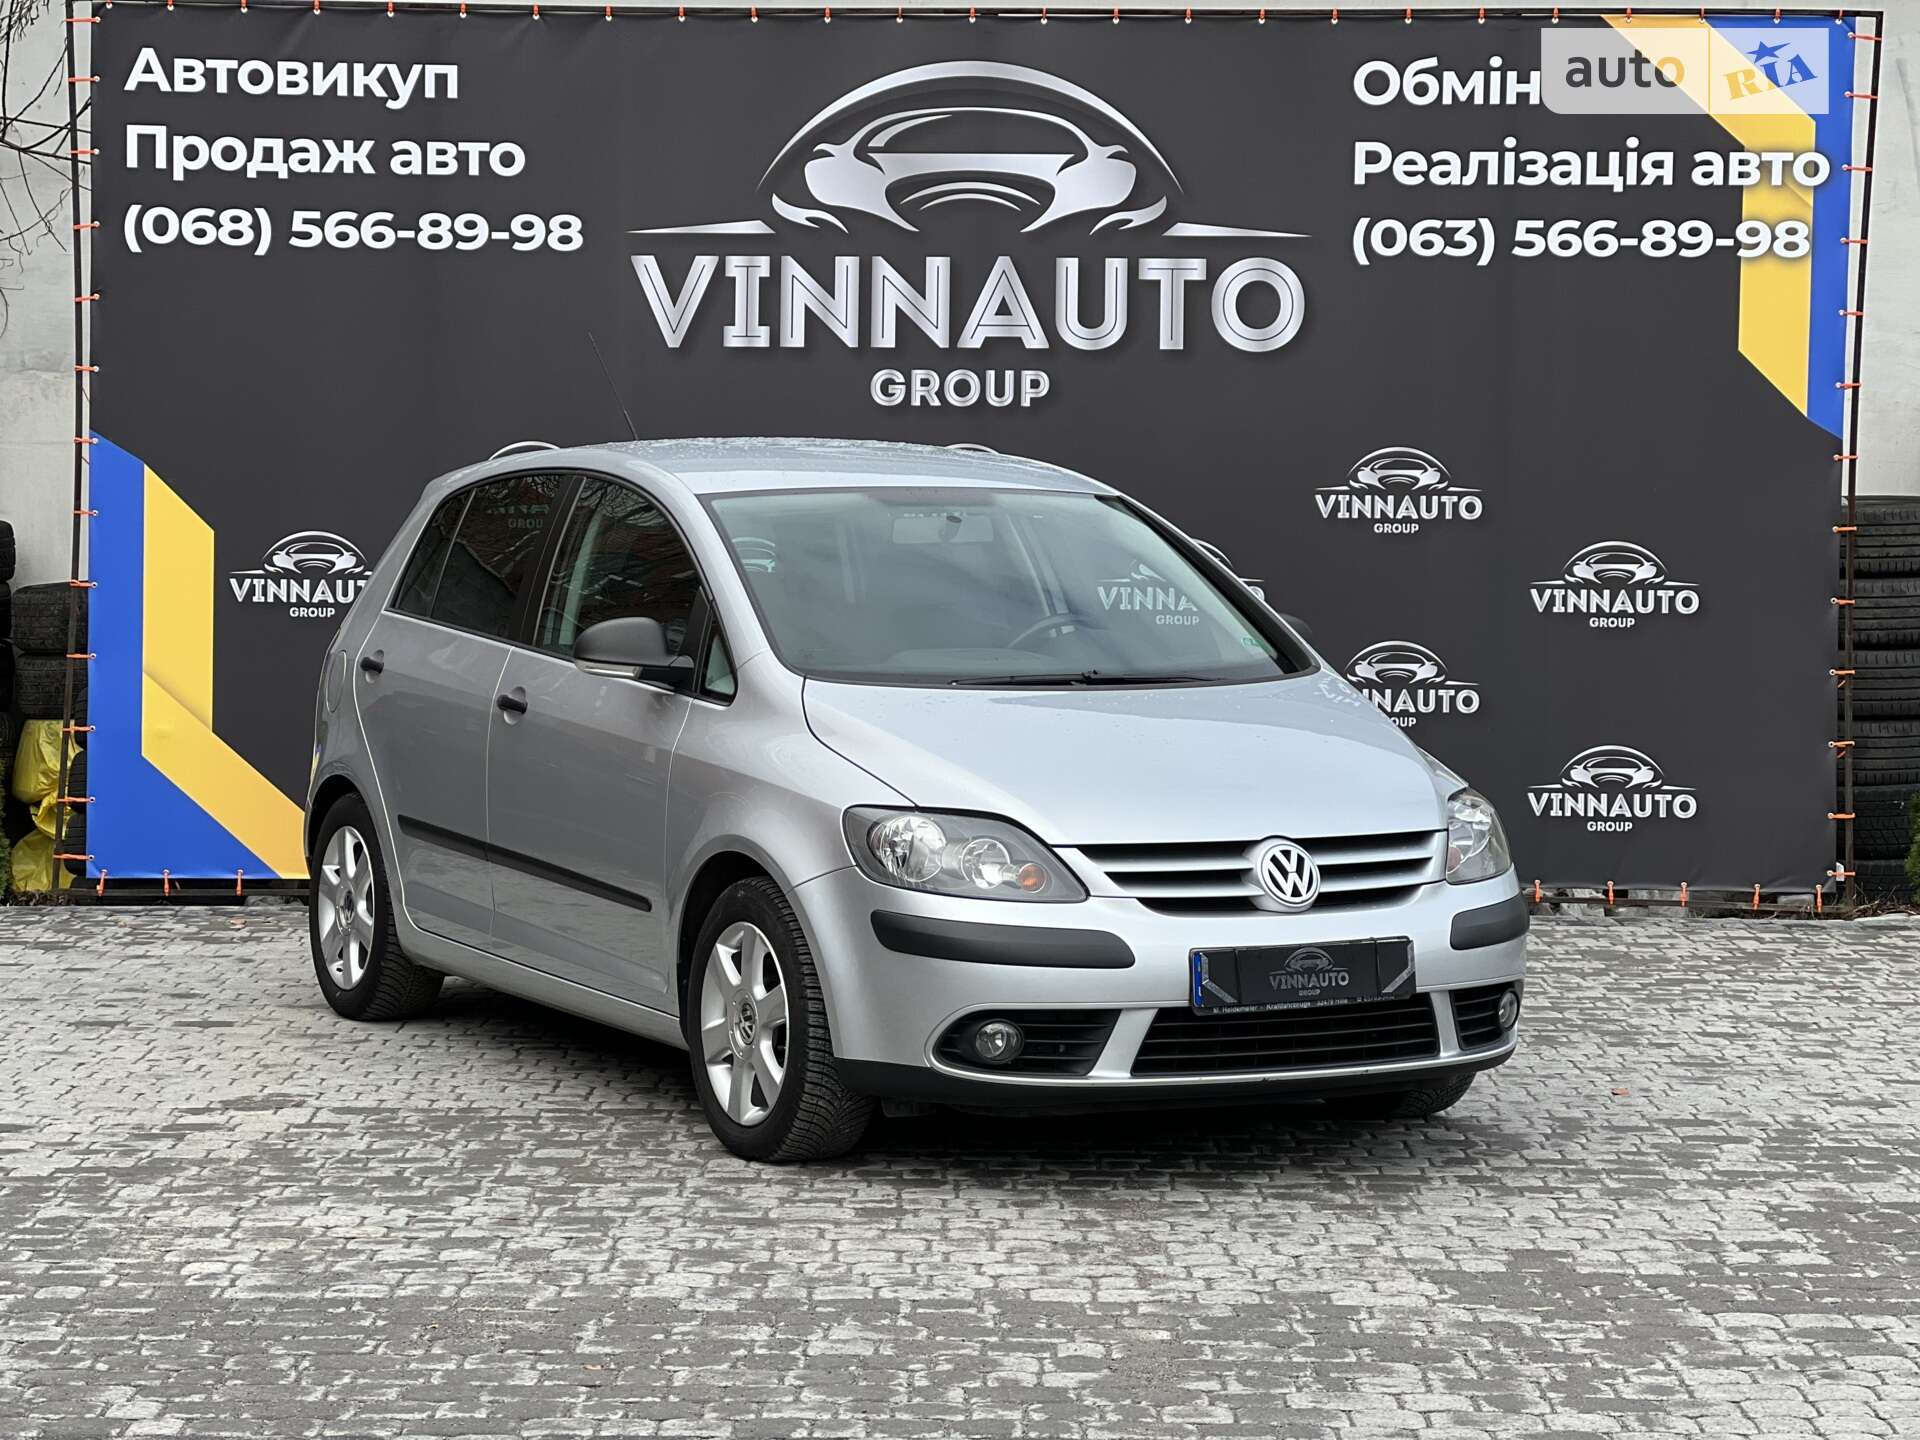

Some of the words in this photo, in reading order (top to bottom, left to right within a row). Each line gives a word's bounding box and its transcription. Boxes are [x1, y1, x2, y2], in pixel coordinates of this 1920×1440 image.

[124, 47, 458, 110] Автовикуп
[1353, 55, 1541, 106] Обмін
[126, 124, 376, 182] Продаж
[389, 140, 526, 177] авто
[1353, 136, 1674, 193] Реалізація
[1691, 150, 1831, 187] авто
[124, 204, 272, 256] (068)
[288, 210, 584, 252] 566-89-98
[1352, 217, 1495, 266] (063)
[1512, 219, 1810, 258] 566-89-98
[630, 254, 1305, 353] VINNAUTO
[870, 368, 1050, 407] GROUP
[1315, 494, 1483, 520] VINNAUTO
[1373, 522, 1419, 534] GROUP
[229, 578, 368, 604] VINNAU
[1531, 588, 1700, 615] VINNAUTO
[289, 606, 336, 618] GROUP
[1155, 614, 1200, 625] GROUP
[1589, 617, 1636, 628] GROUP
[1361, 688, 1480, 714] NAUTO
[1390, 716, 1417, 727] OUP
[1528, 792, 1697, 819] VINNAUTO
[1586, 821, 1633, 832] GROUP
[1269, 971, 1350, 991] VINNAUTO
